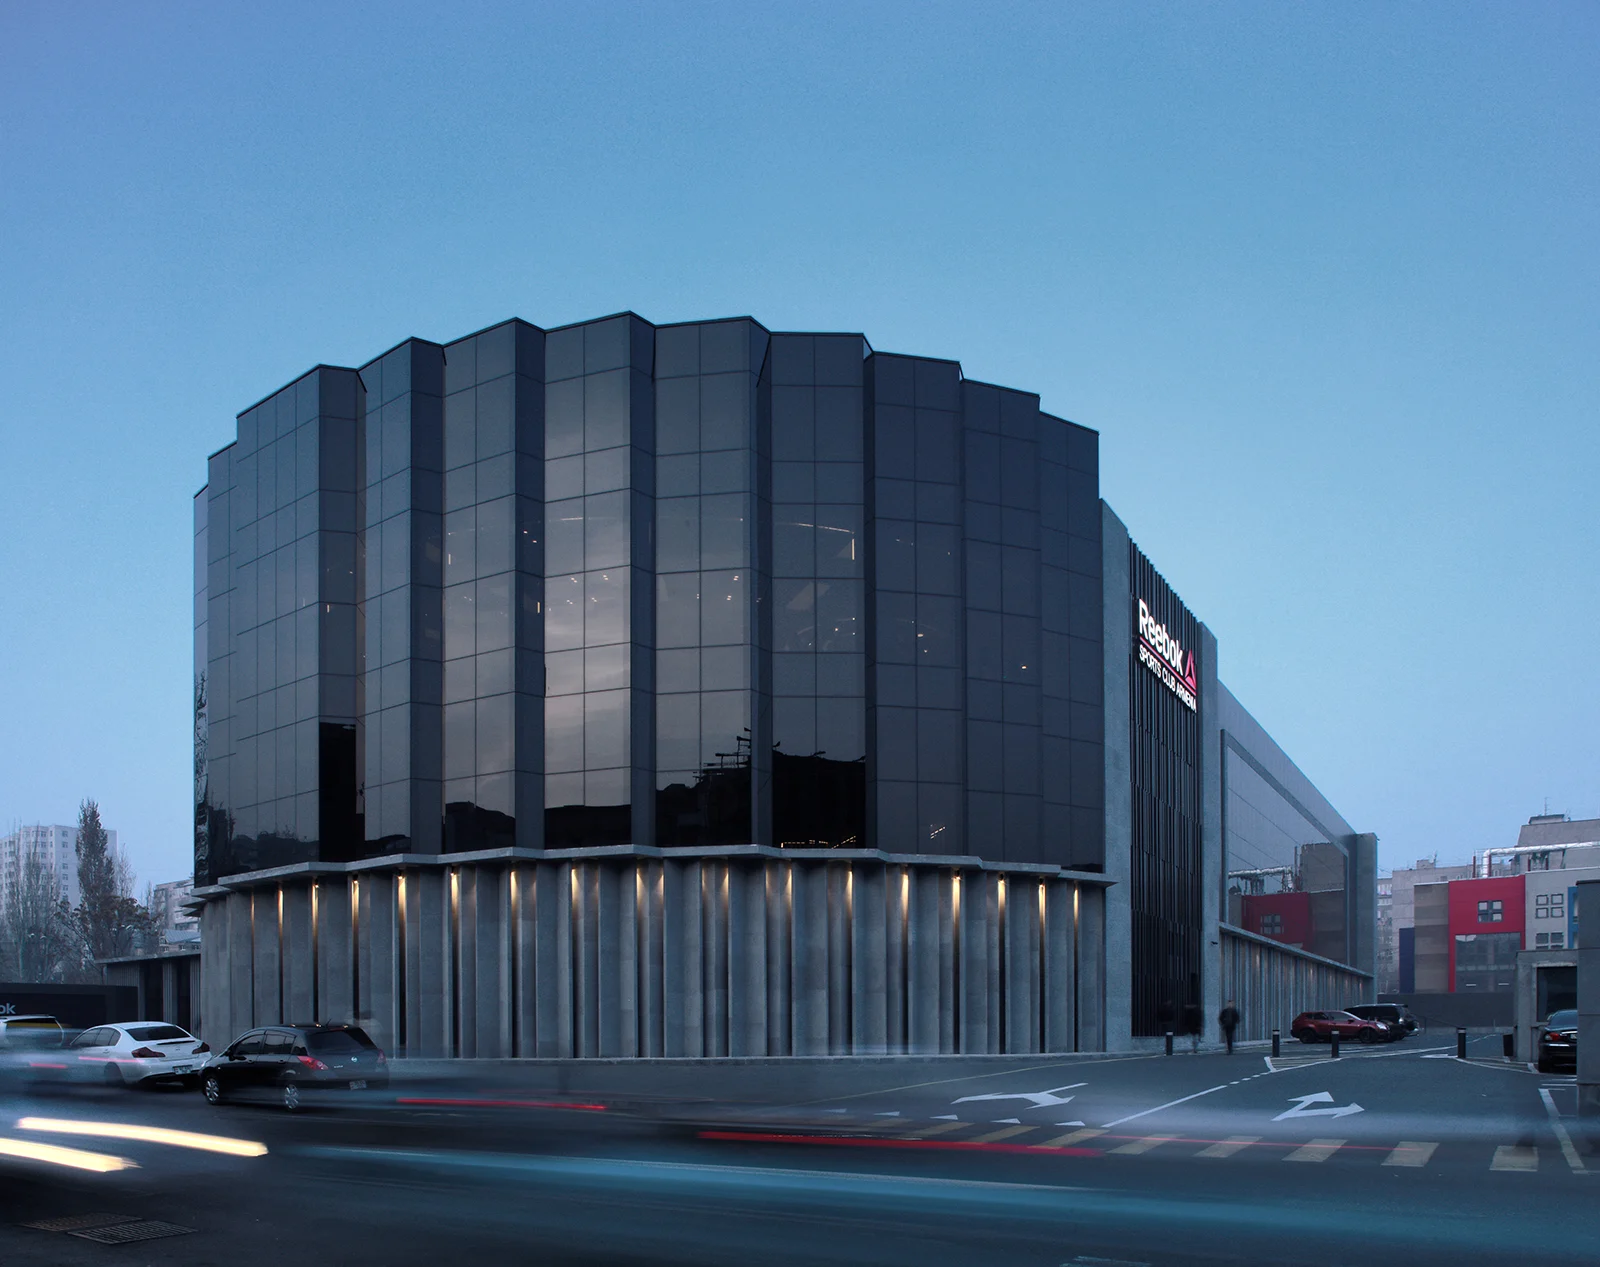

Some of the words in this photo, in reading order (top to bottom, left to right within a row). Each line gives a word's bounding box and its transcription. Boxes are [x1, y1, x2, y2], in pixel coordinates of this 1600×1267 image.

[1139, 599, 1183, 675] Reebok
[1139, 645, 1161, 678] SPORTS
[1162, 667, 1176, 692] CLUB
[1176, 682, 1197, 713] ARMENIA
